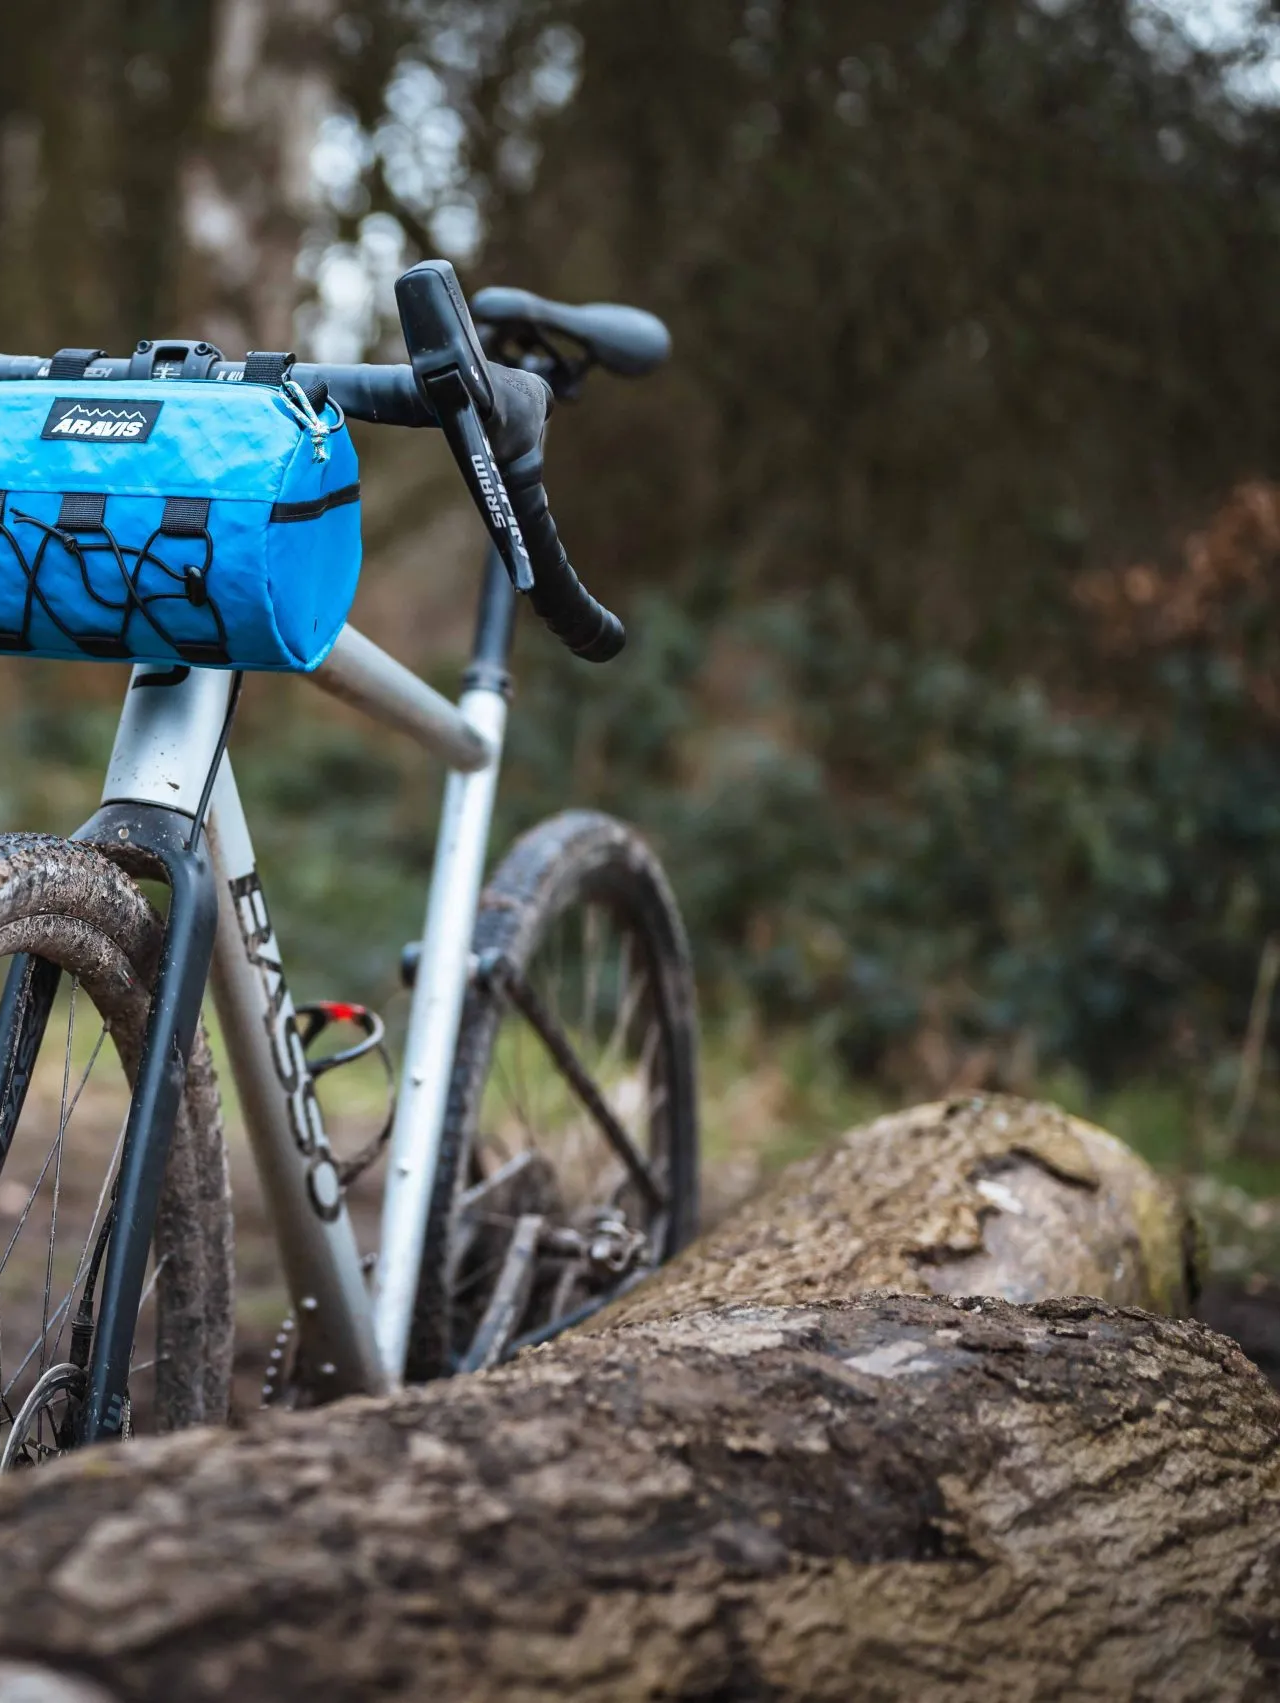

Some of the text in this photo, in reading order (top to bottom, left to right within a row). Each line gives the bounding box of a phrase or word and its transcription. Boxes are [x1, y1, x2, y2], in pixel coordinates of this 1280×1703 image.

[51, 418, 143, 437] ARAVIS
[471, 454, 506, 528] SRAM
[228, 871, 341, 1223] BASSO
